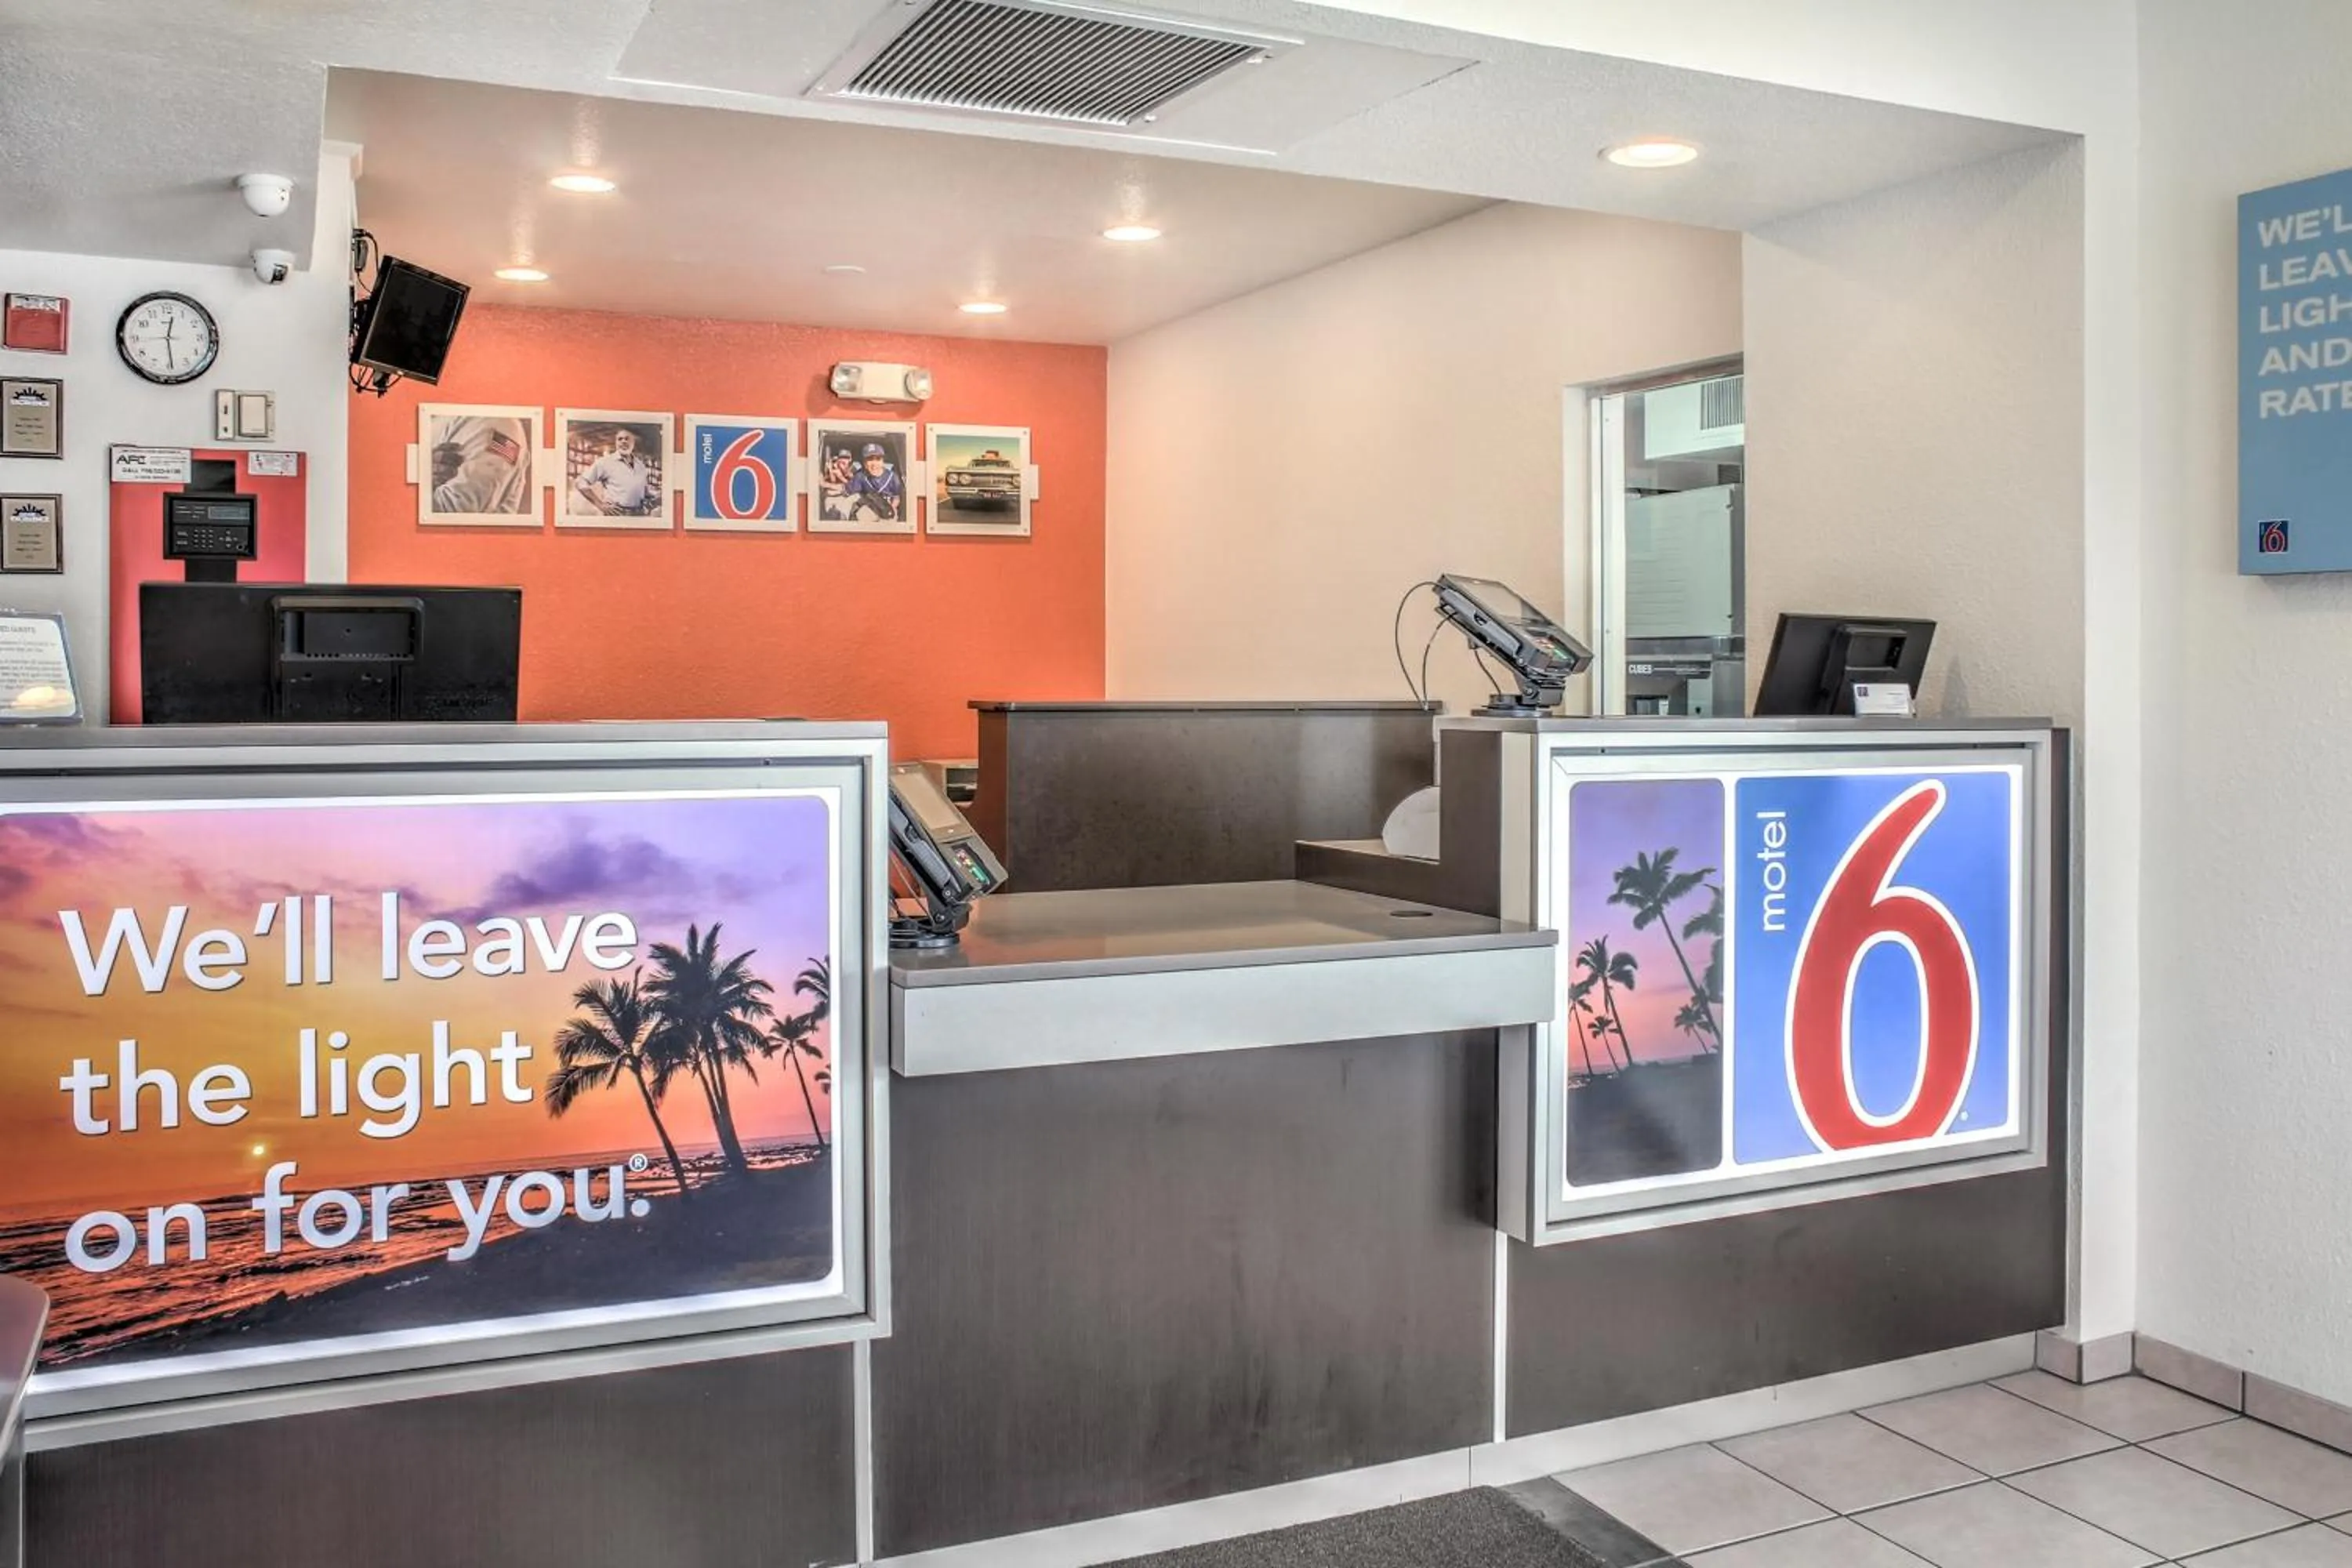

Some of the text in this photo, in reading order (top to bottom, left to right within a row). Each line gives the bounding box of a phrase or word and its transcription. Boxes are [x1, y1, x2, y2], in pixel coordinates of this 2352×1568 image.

[2258, 338, 2352, 376] AND
[2259, 293, 2352, 333] LIGH
[702, 434, 713, 463] motel
[710, 430, 776, 521] 6
[2263, 521, 2285, 553] 6
[1756, 811, 1787, 931] motel
[58, 891, 637, 996] We'll leave
[1784, 778, 1980, 1156] 6
[59, 1019, 534, 1138] the light
[64, 1201, 207, 1272] on
[252, 1160, 409, 1254] for
